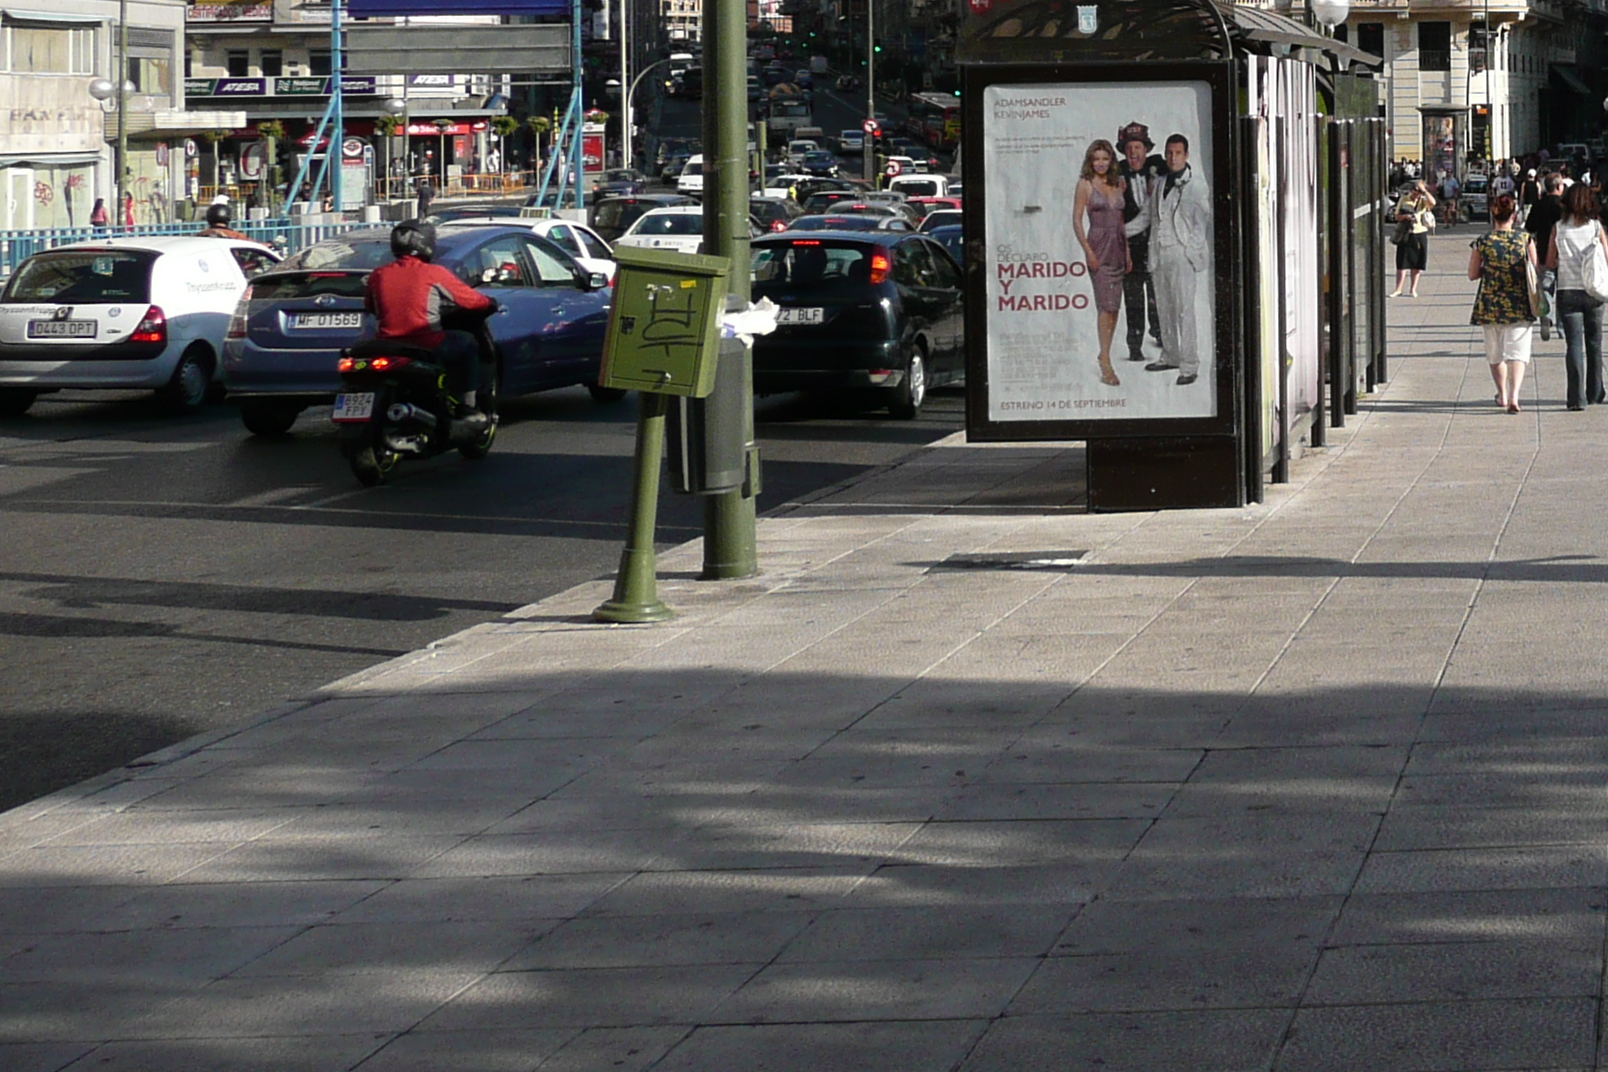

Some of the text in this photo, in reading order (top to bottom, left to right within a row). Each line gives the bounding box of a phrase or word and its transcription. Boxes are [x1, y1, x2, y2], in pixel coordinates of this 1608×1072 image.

[221, 82, 261, 92] ATESA
[997, 252, 1049, 263] DECLARO
[997, 261, 1086, 279] MARIDO
[999, 279, 1014, 295] Y
[998, 294, 1089, 311] MARIDO
[318, 313, 359, 325] 01569
[797, 308, 820, 321] BLF
[36, 323, 93, 334] 0443 DPT
[1000, 398, 1127, 411] ESTRENO 14 DE SEPTIEMBRE
